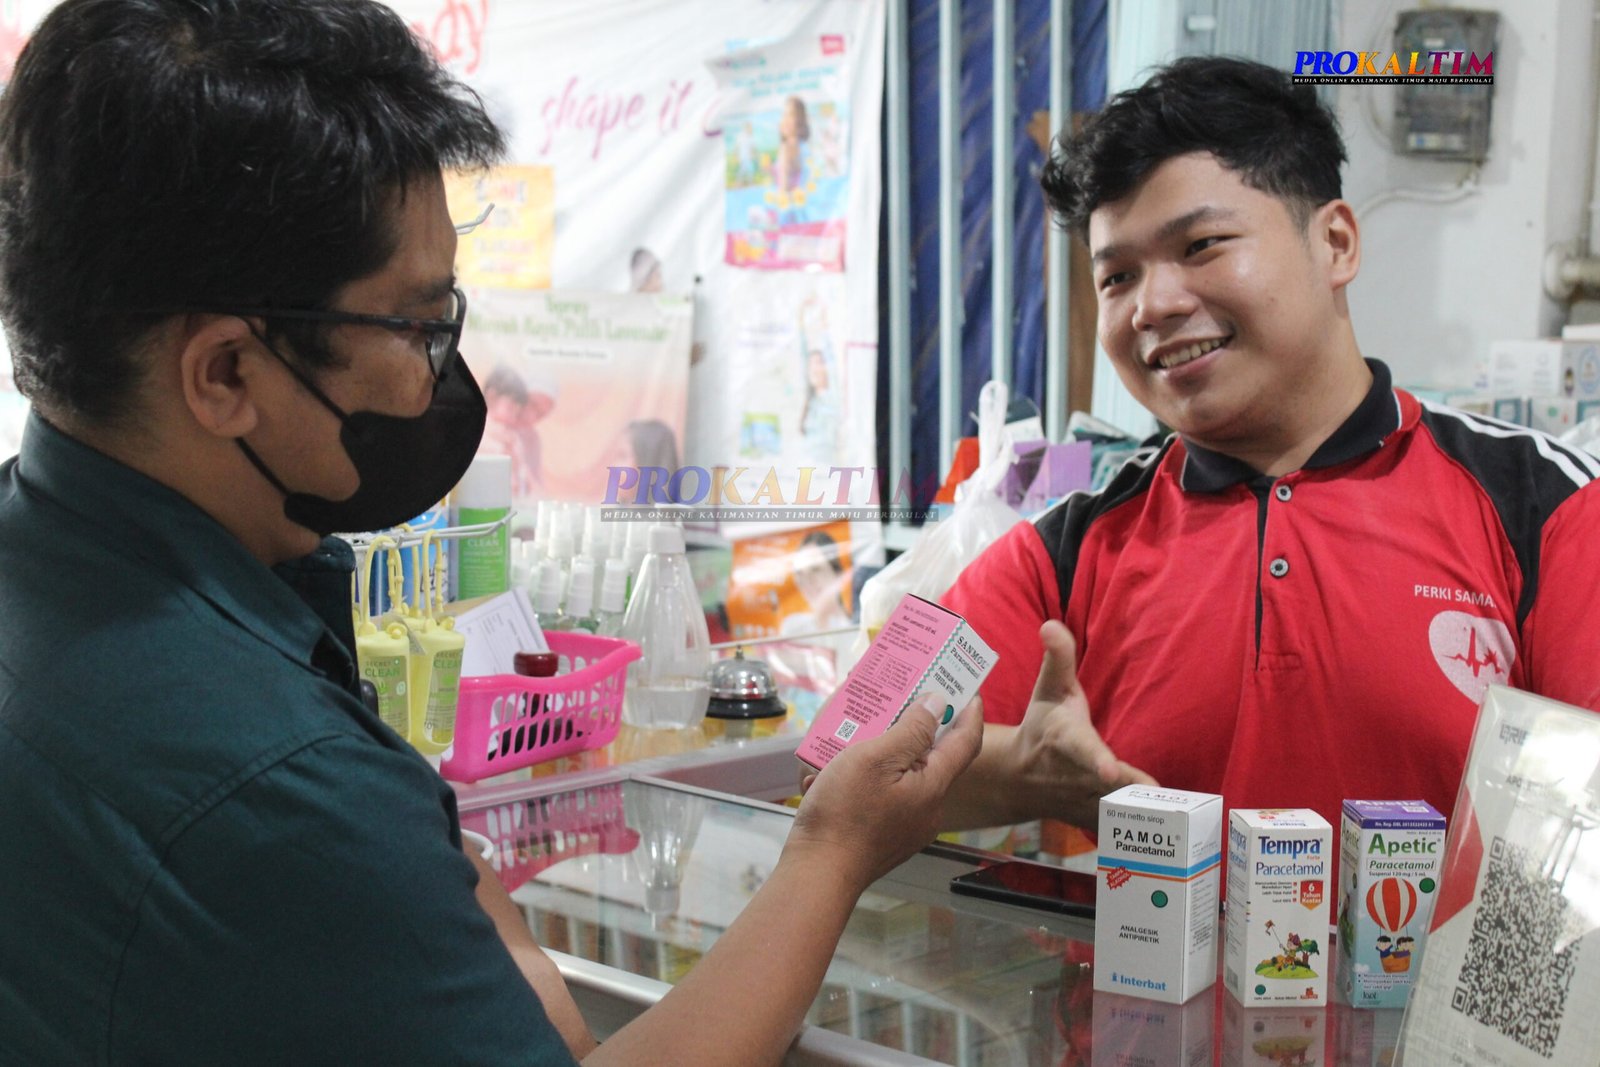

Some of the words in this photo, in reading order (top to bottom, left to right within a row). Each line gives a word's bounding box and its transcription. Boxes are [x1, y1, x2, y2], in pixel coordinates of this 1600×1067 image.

[540, 76, 645, 160] shape
[658, 80, 695, 135] it
[1414, 584, 1451, 600] PERKI
[1455, 589, 1496, 608] SAMA
[957, 636, 987, 670] SANMOL
[950, 647, 980, 679] Paracetamol
[1106, 808, 1116, 816] 60
[1128, 813, 1145, 821] netto
[1147, 816, 1164, 825] sirop
[1113, 827, 1175, 847] PAMOL
[1368, 833, 1436, 857] Apetic
[1116, 840, 1175, 858] Paracetamol
[1258, 836, 1320, 859] Tempra
[1256, 861, 1324, 876] Paracetamol
[1370, 860, 1435, 870] Paracetamol
[1308, 883, 1315, 892] 6
[1119, 932, 1159, 944] ANTIPIRETIK
[1121, 925, 1159, 936] ANALGESIK
[1120, 974, 1166, 991] Interbat
